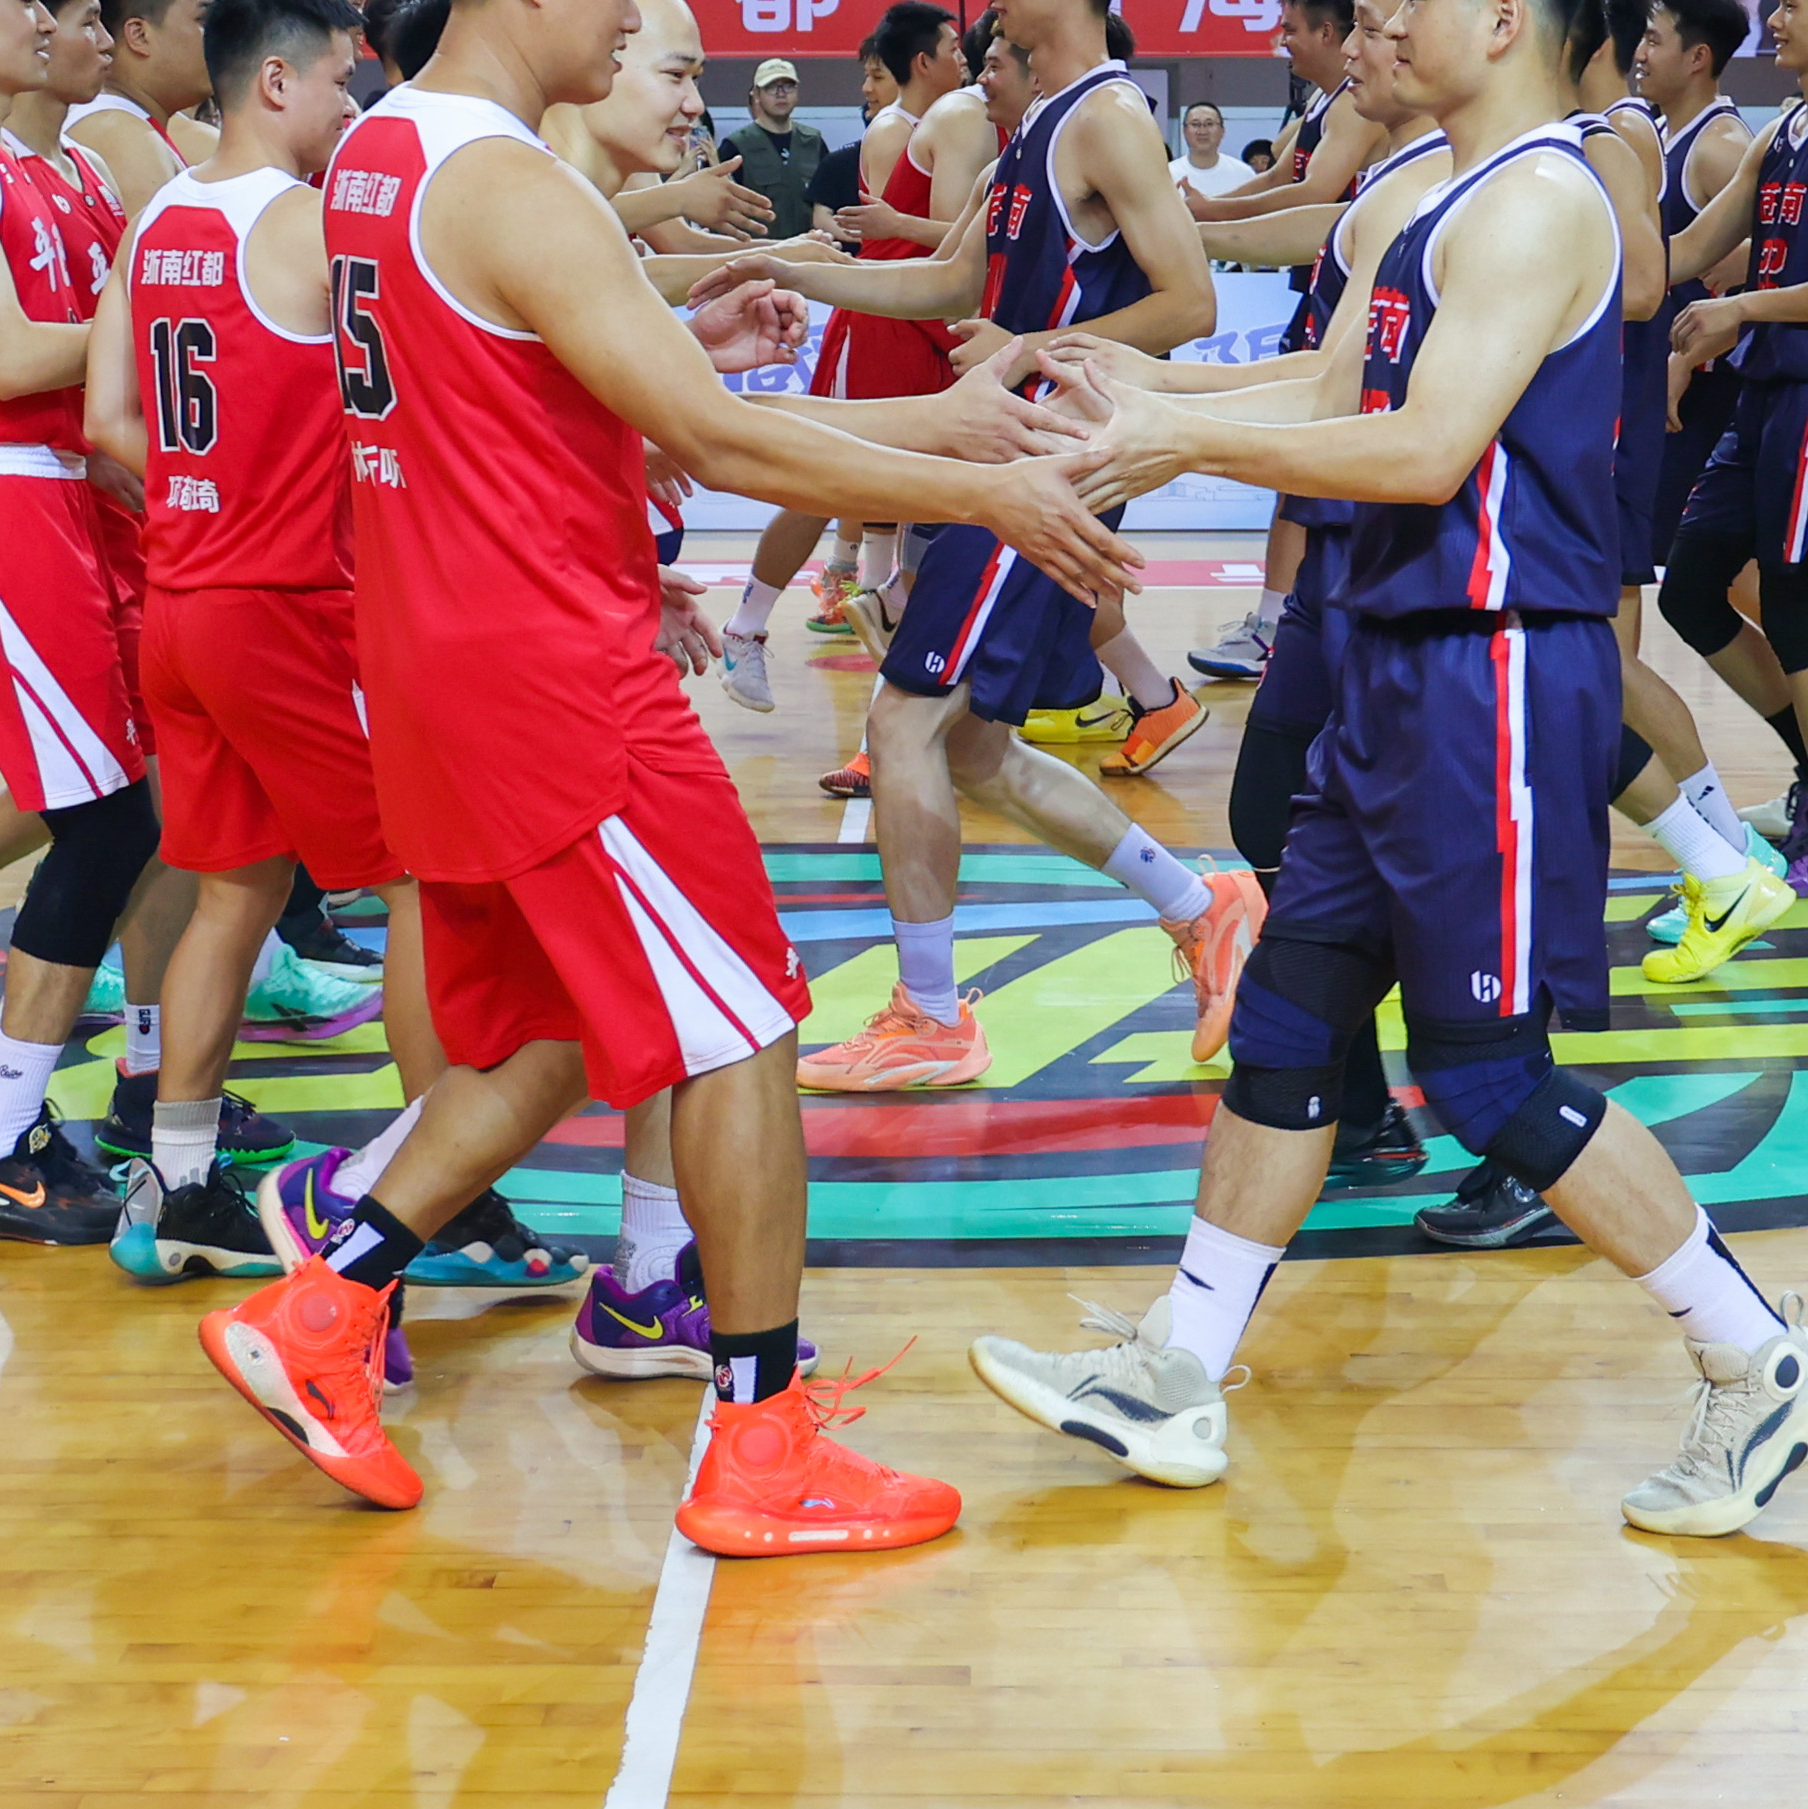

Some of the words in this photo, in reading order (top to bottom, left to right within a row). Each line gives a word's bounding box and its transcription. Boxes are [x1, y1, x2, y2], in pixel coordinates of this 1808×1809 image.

[330, 169, 402, 217] 浙南红都
[140, 248, 225, 288] 浙南红都
[149, 316, 219, 456] 16
